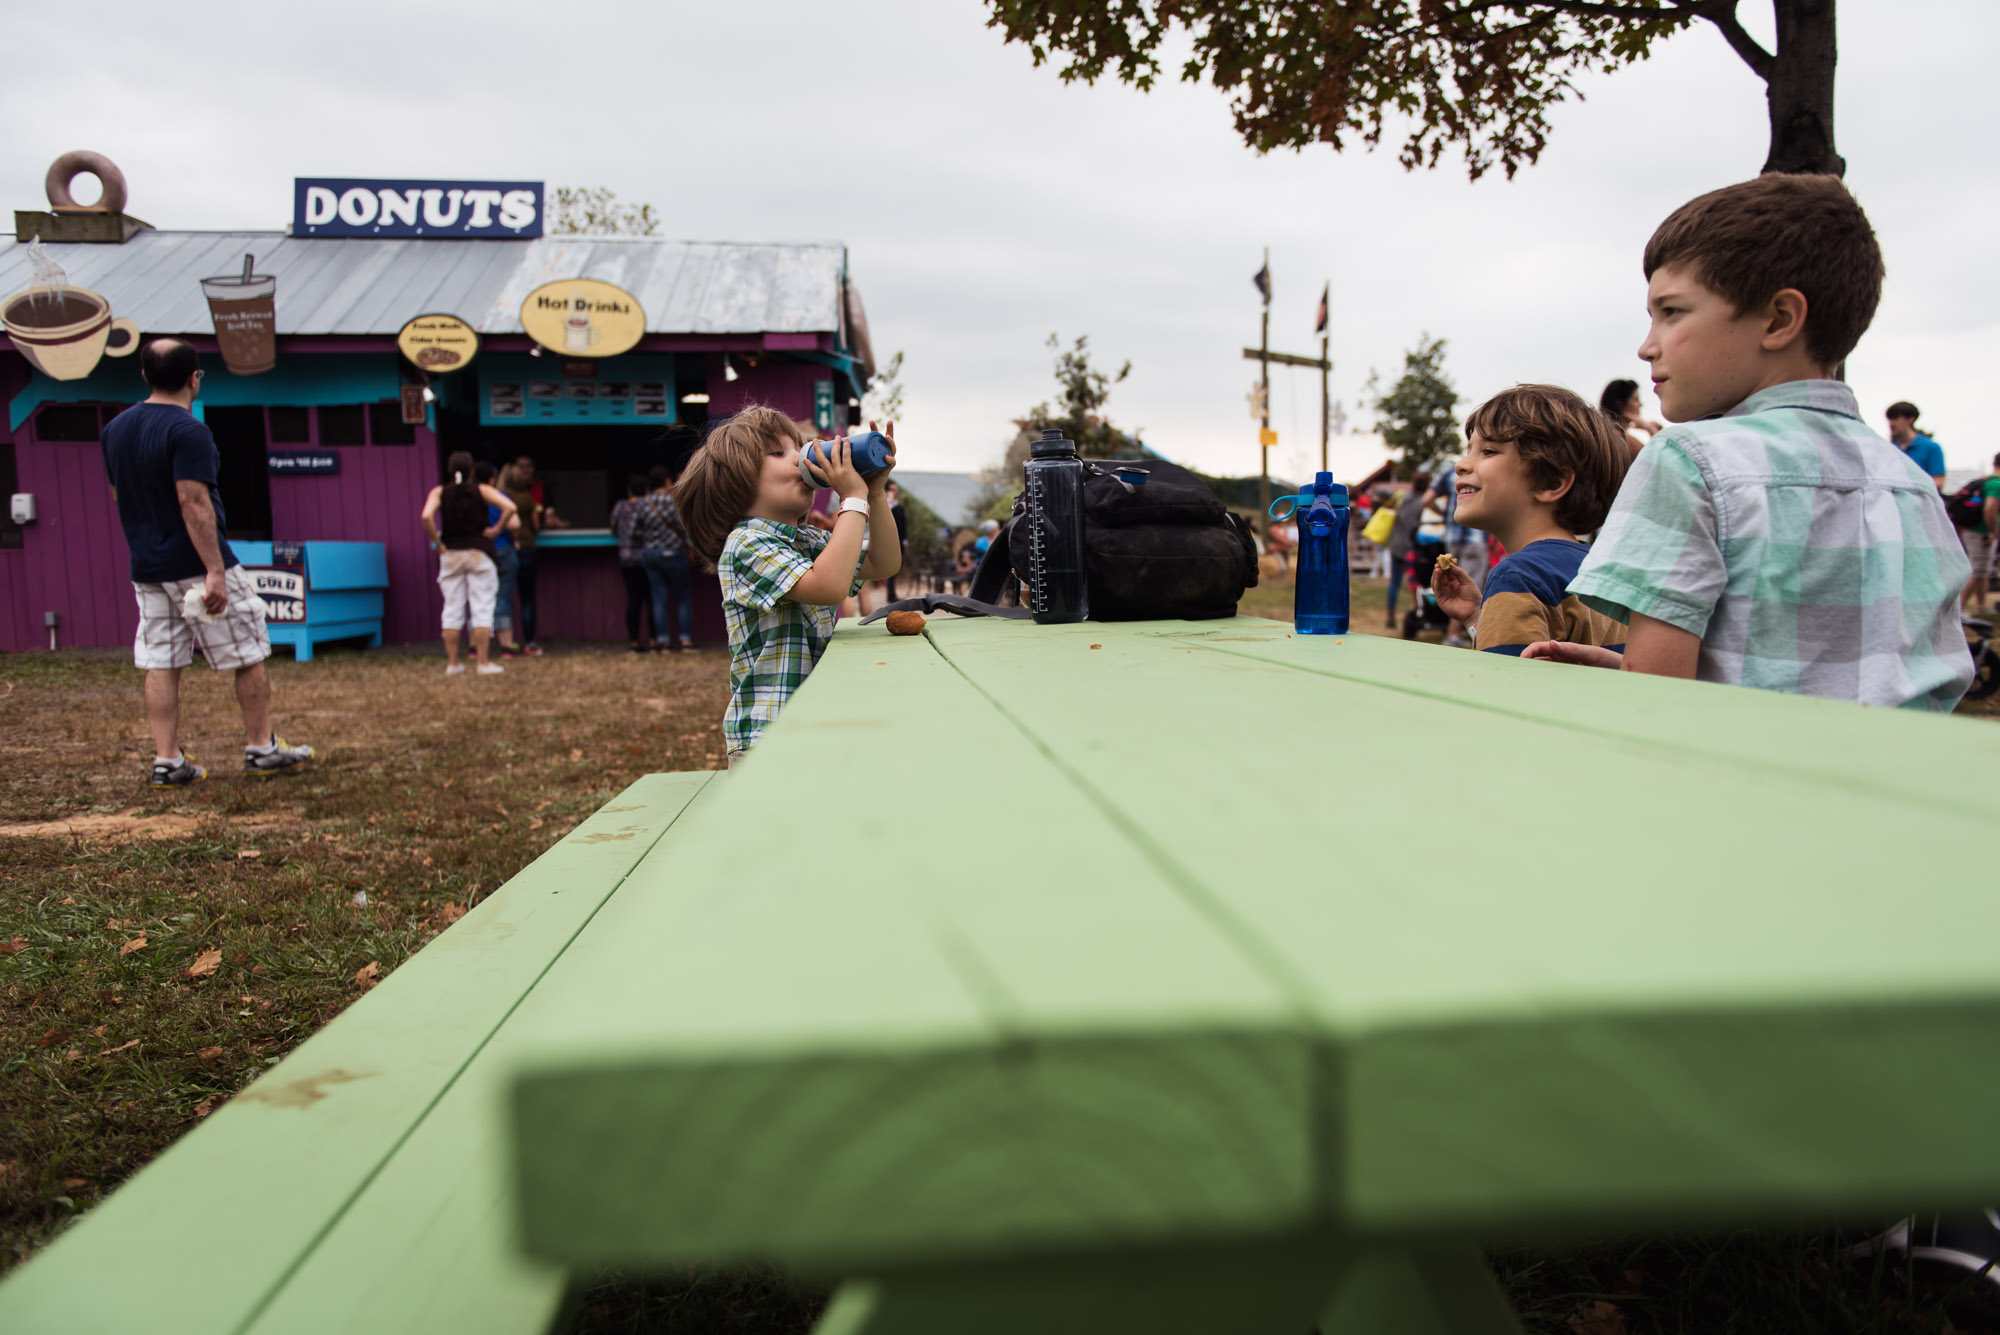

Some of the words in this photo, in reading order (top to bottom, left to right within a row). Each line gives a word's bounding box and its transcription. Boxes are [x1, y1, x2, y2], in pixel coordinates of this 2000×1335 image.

[306, 186, 536, 230] DONUTS
[538, 296, 568, 310] Hot
[575, 300, 630, 314] Drinks
[269, 456, 295, 469] Open
[257, 576, 296, 591] COLD
[265, 600, 304, 620] NKS
